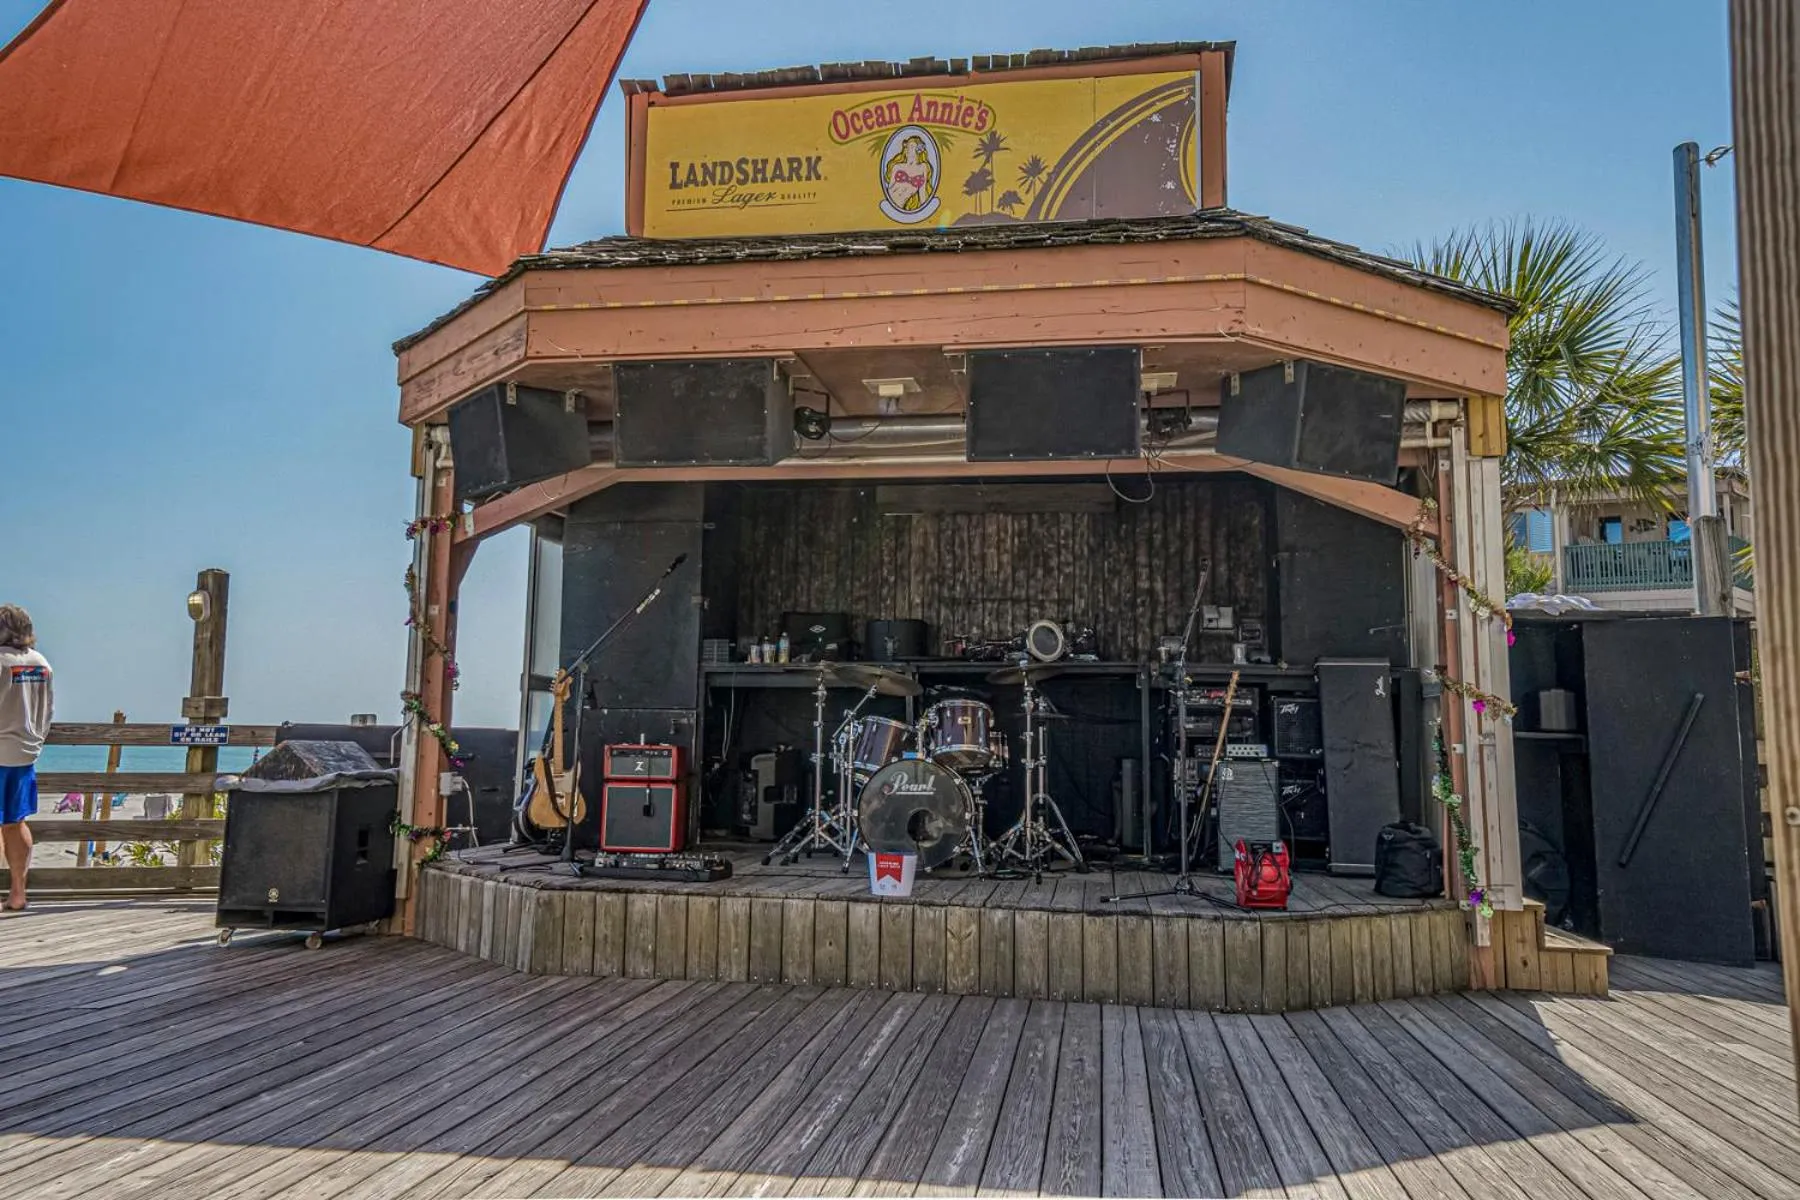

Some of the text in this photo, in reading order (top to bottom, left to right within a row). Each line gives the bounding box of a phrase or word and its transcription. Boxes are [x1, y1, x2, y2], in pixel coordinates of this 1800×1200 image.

[832, 93, 989, 140] Ocean Annie's
[669, 156, 822, 190] LANDSHARK
[711, 184, 777, 210] Lager
[883, 771, 936, 795] Pearl
